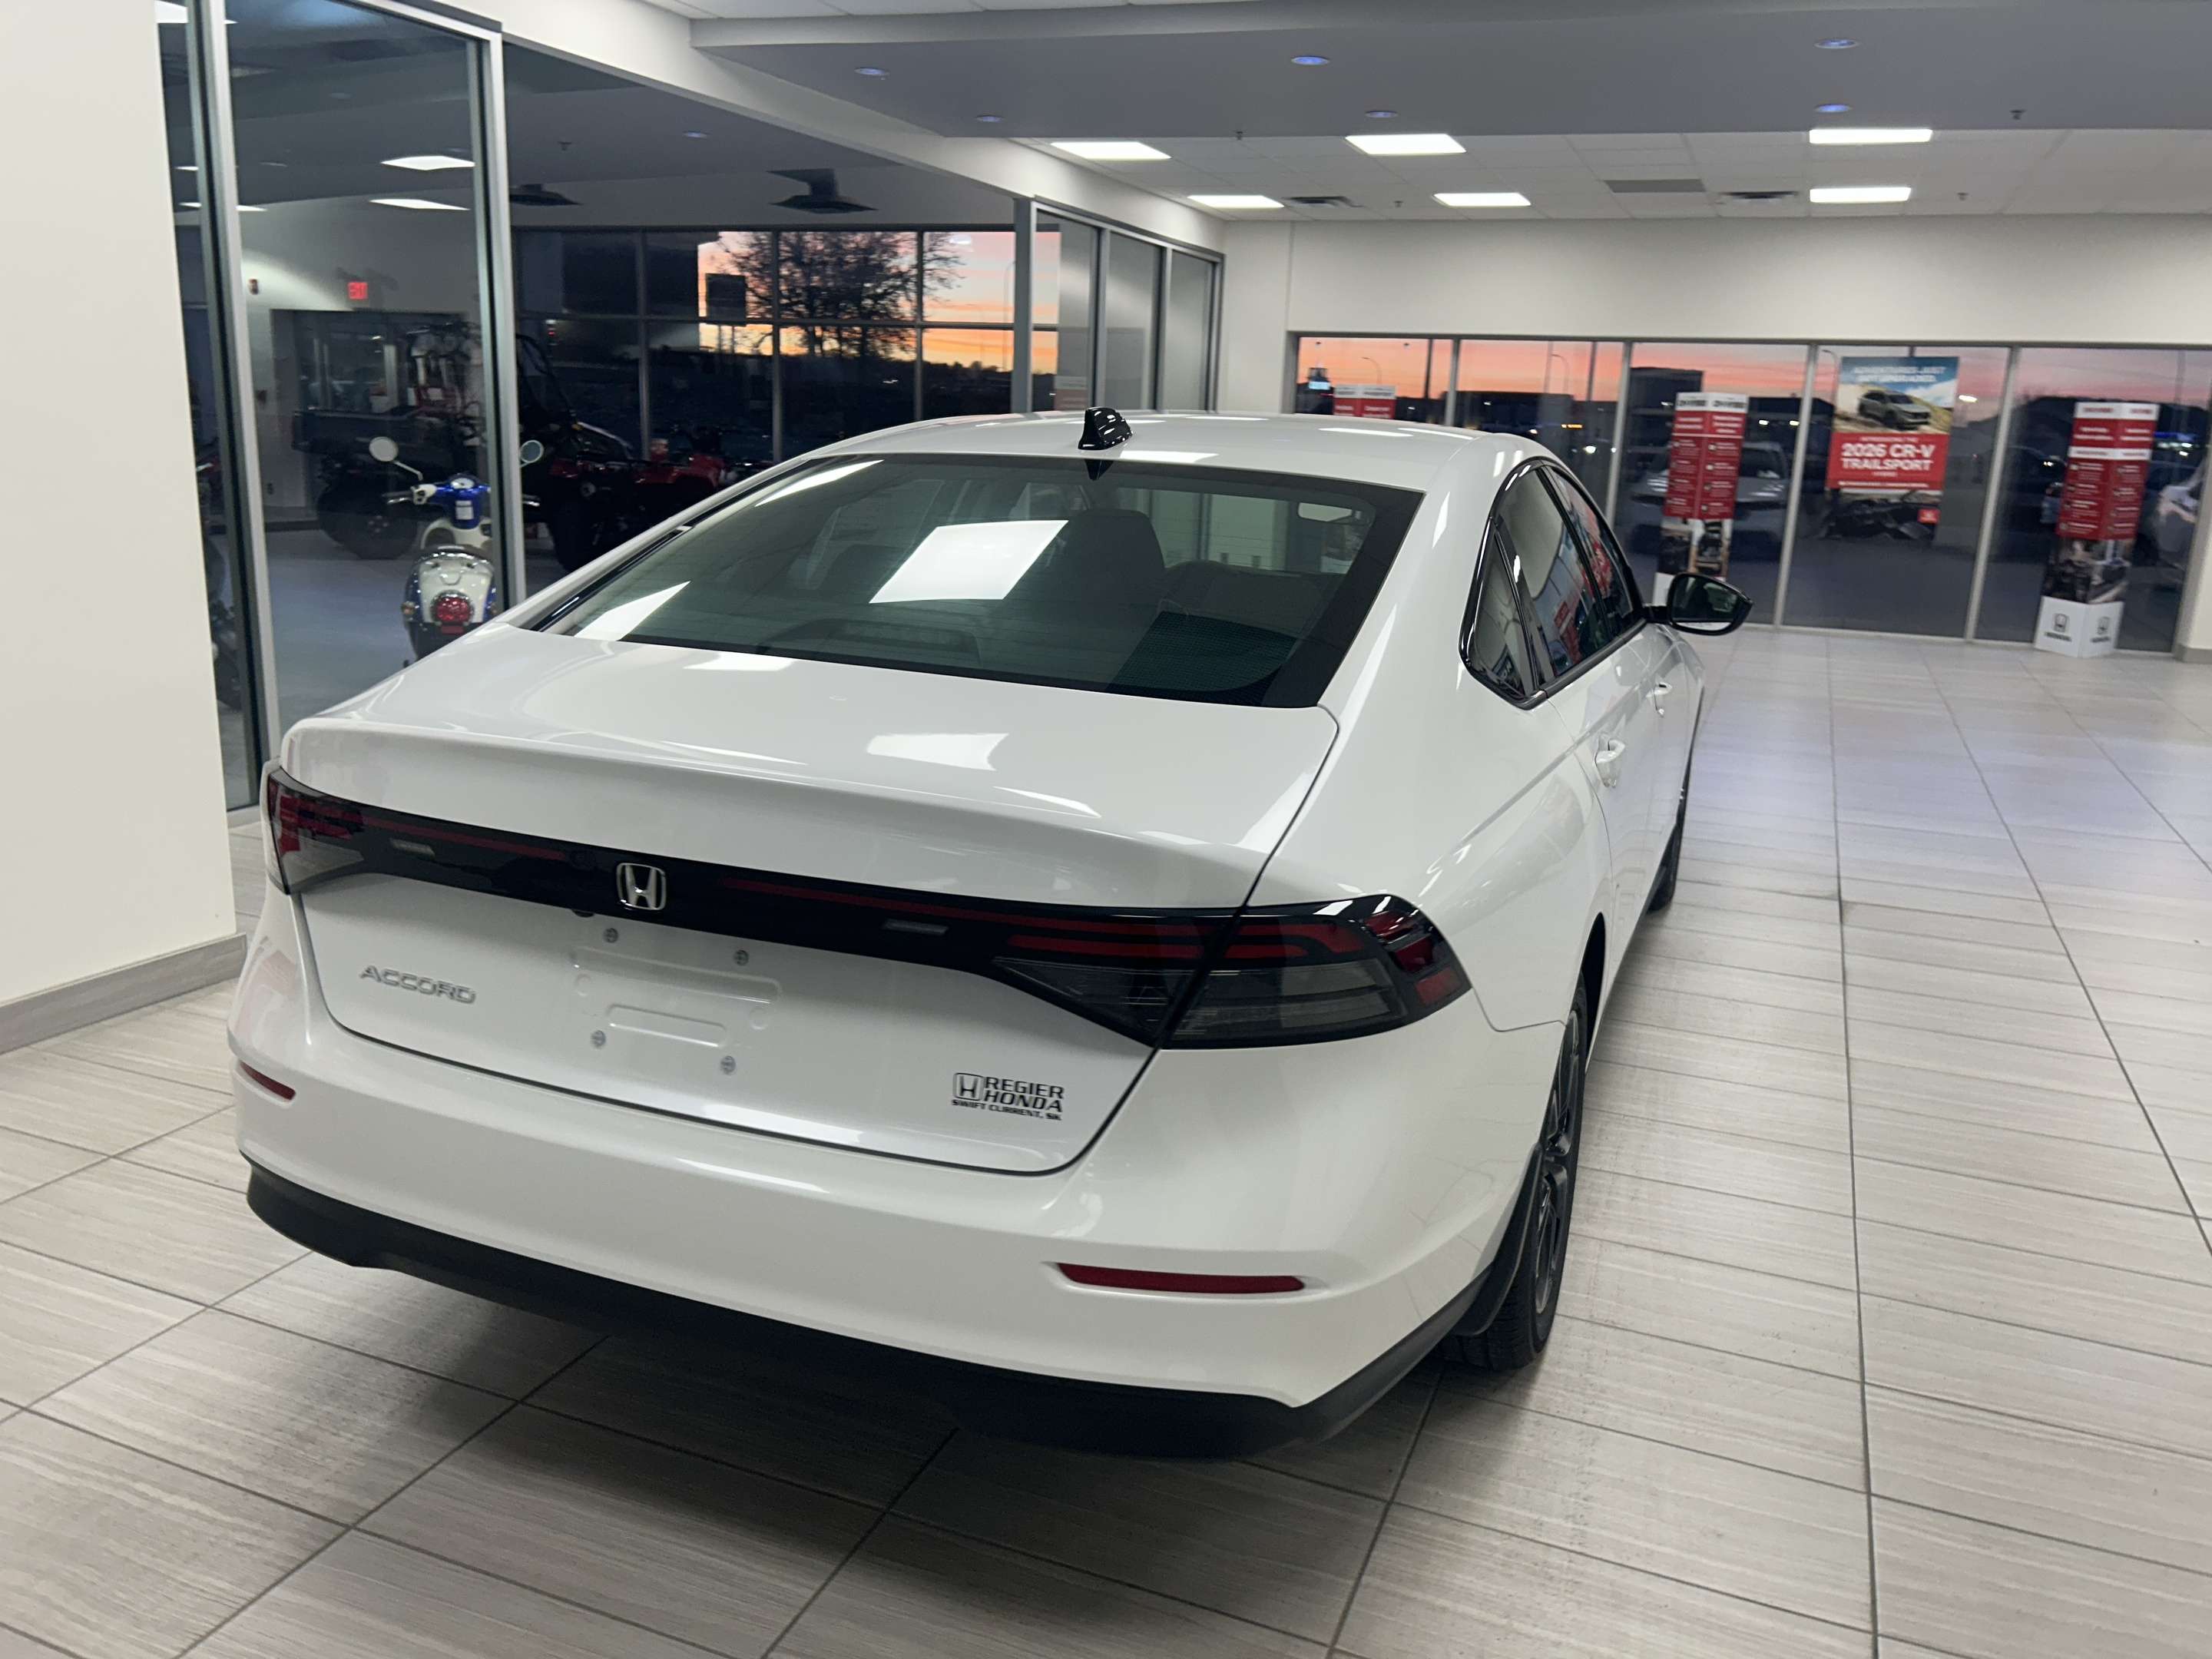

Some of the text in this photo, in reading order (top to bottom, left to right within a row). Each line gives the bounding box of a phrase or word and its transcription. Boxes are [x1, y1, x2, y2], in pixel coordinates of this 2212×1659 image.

[1842, 443, 1936, 459] 2026 CR-V
[1841, 458, 1933, 471] TRAILSPORT
[359, 965, 476, 1004] ACCORD
[985, 1076, 1065, 1099] REGIER
[952, 1099, 986, 1110] SWIFT
[984, 1090, 1063, 1112] HONDA
